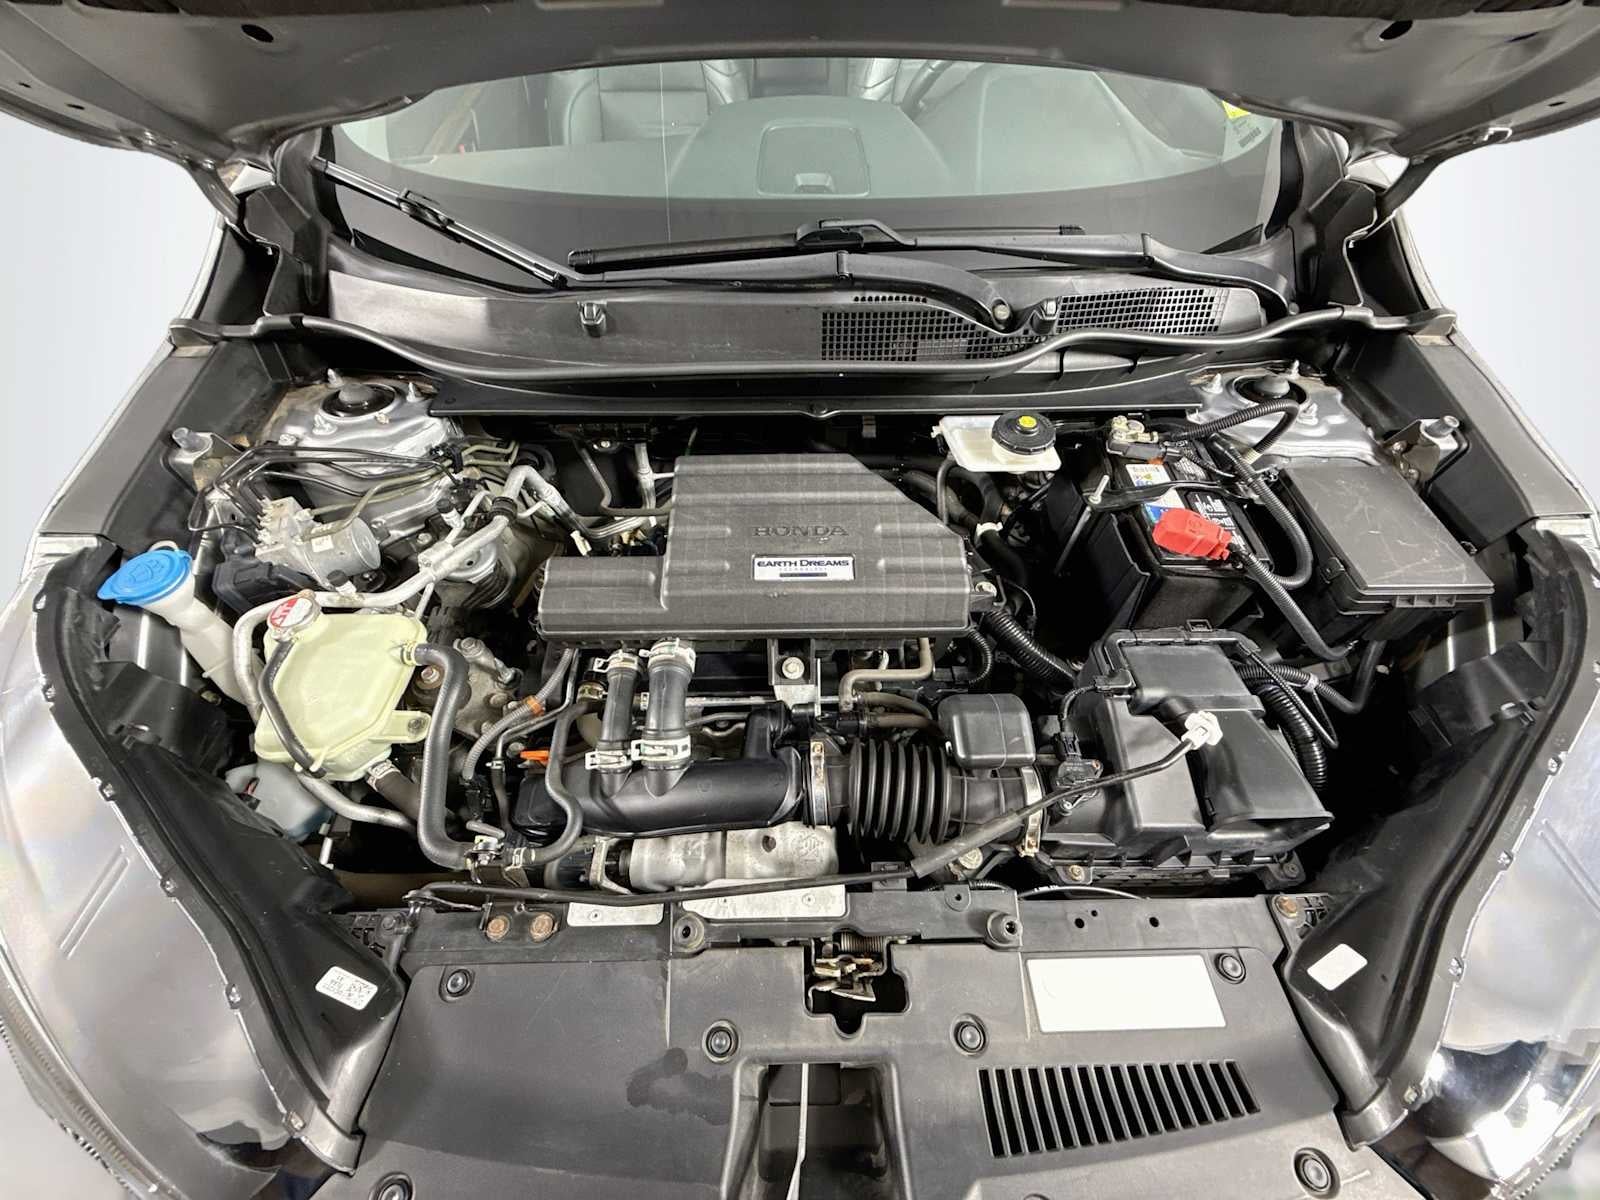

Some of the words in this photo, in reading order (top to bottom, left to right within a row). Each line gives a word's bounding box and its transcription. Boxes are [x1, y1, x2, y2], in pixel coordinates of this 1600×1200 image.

[753, 525, 849, 537] HONDA
[757, 559, 797, 567] EARTH
[799, 559, 849, 567] DREAMS
